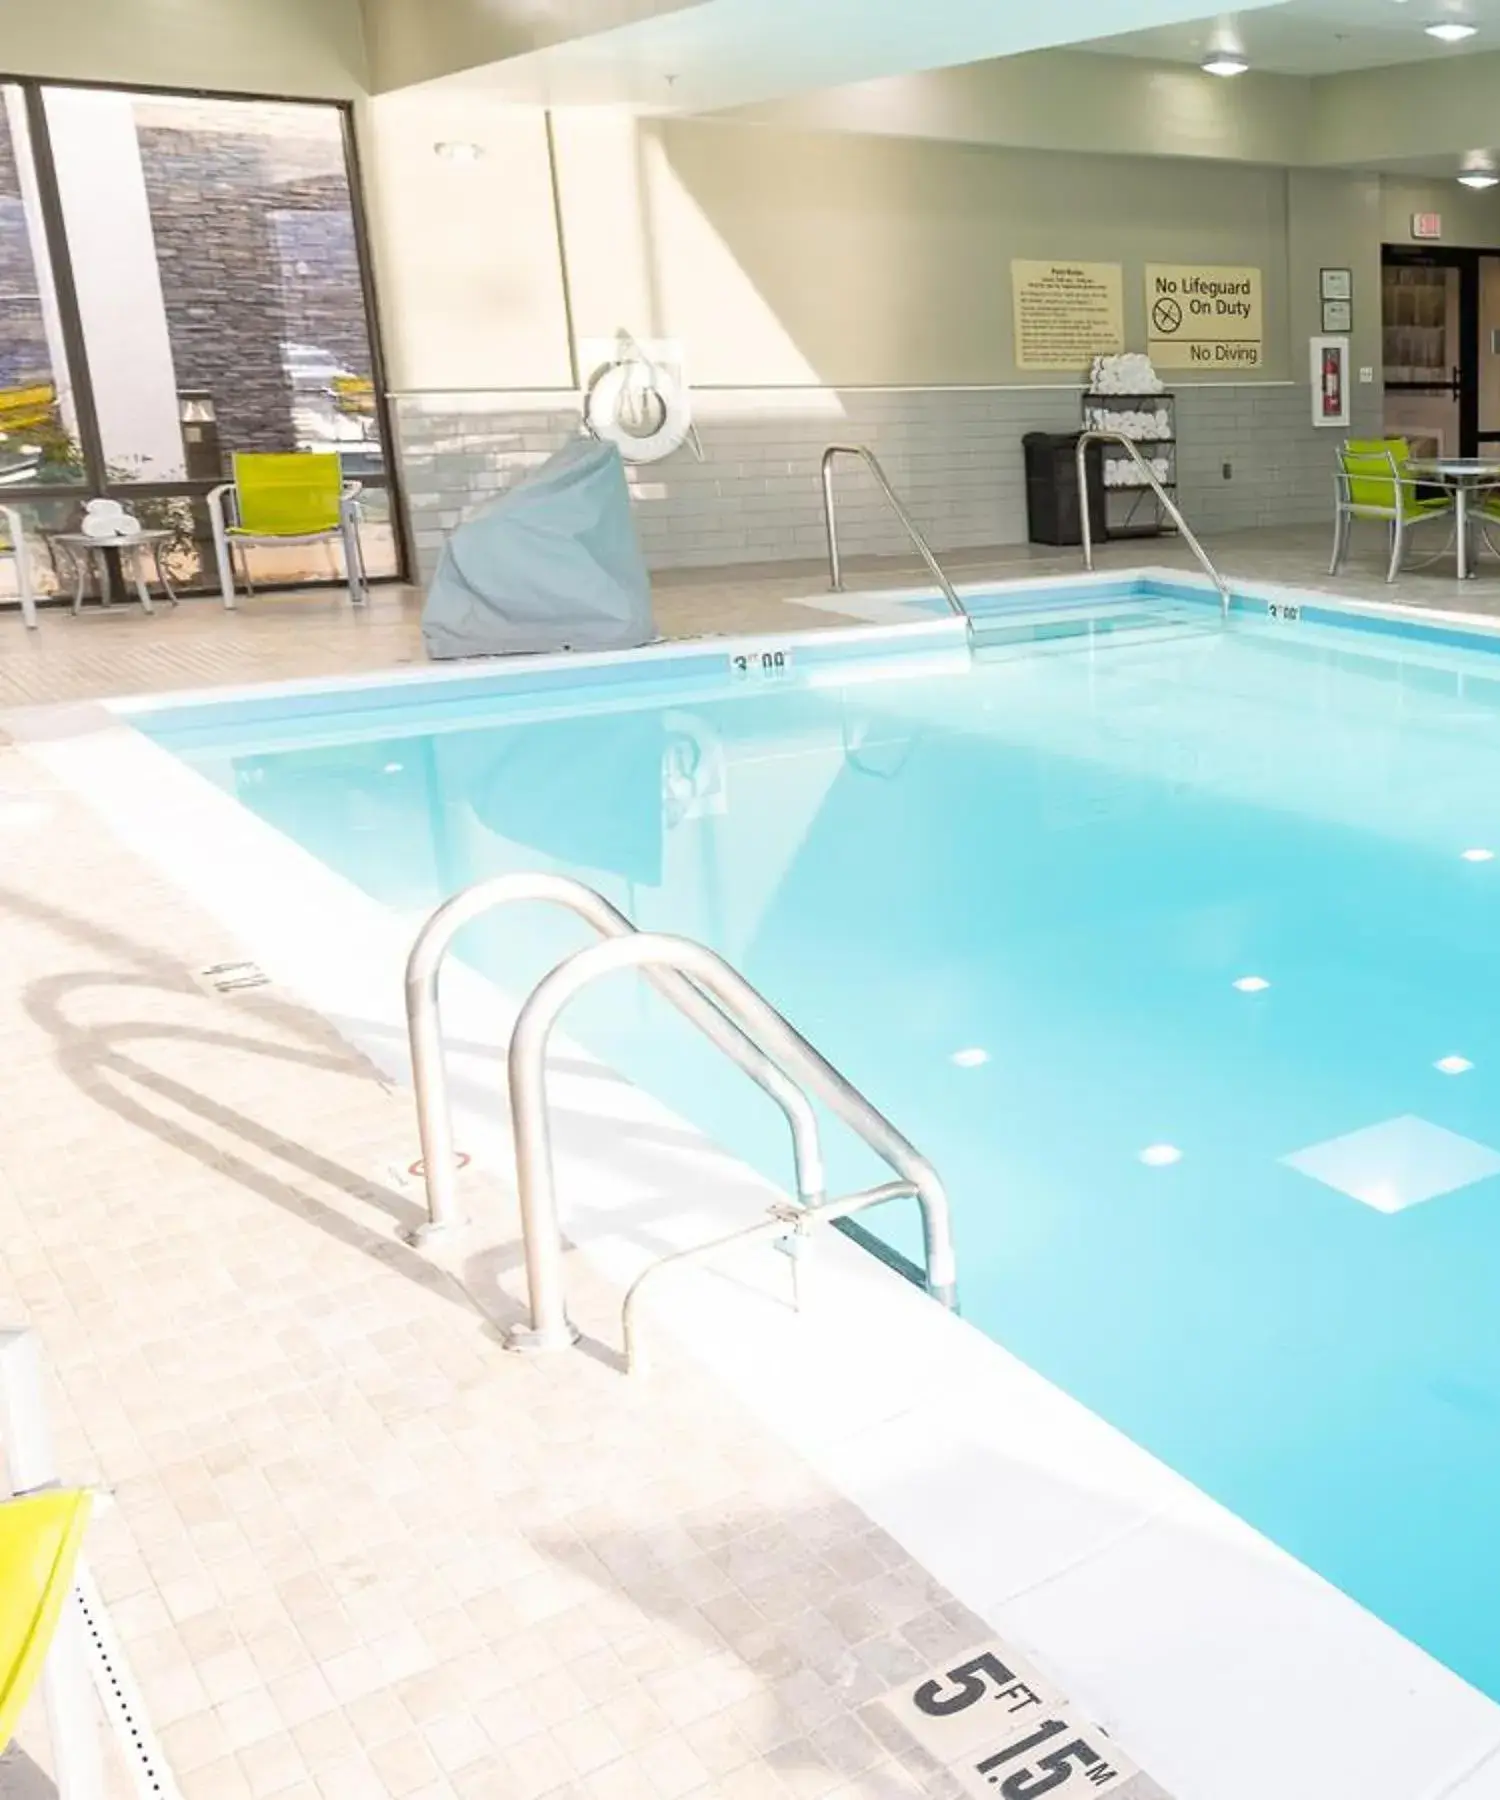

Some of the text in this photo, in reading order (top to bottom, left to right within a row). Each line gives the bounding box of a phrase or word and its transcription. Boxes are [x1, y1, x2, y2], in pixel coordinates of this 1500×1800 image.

[1156, 277, 1251, 298] No Lifeguard
[1189, 299, 1251, 319] On Duty
[1190, 345, 1258, 365] No Diving
